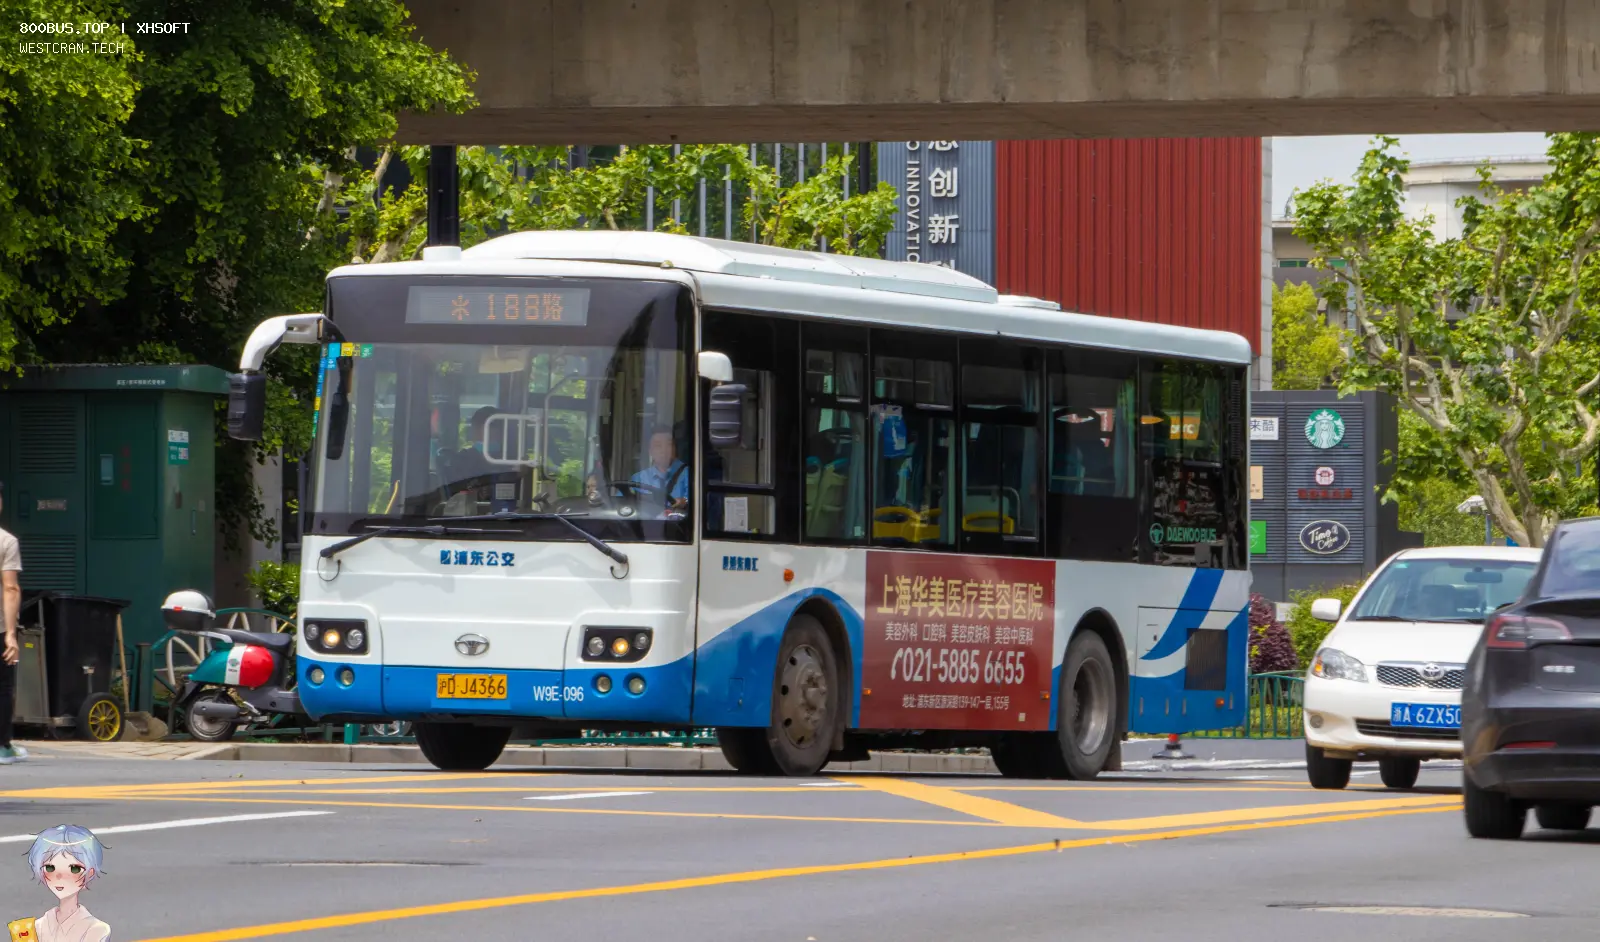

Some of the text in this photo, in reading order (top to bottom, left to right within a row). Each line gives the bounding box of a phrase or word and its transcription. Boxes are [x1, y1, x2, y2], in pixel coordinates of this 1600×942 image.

[928, 140, 960, 271] 创新
[1167, 526, 1217, 542] DAEWOO BUS
[453, 550, 515, 567] 浦东公交
[877, 574, 1044, 621] 上海华美医疗美容医院
[885, 622, 1034, 645] 美容外科 口腔科 美容皮肤科 美容中医科
[902, 647, 1025, 685] 021-5885 6655
[533, 685, 584, 702] W9E-096
